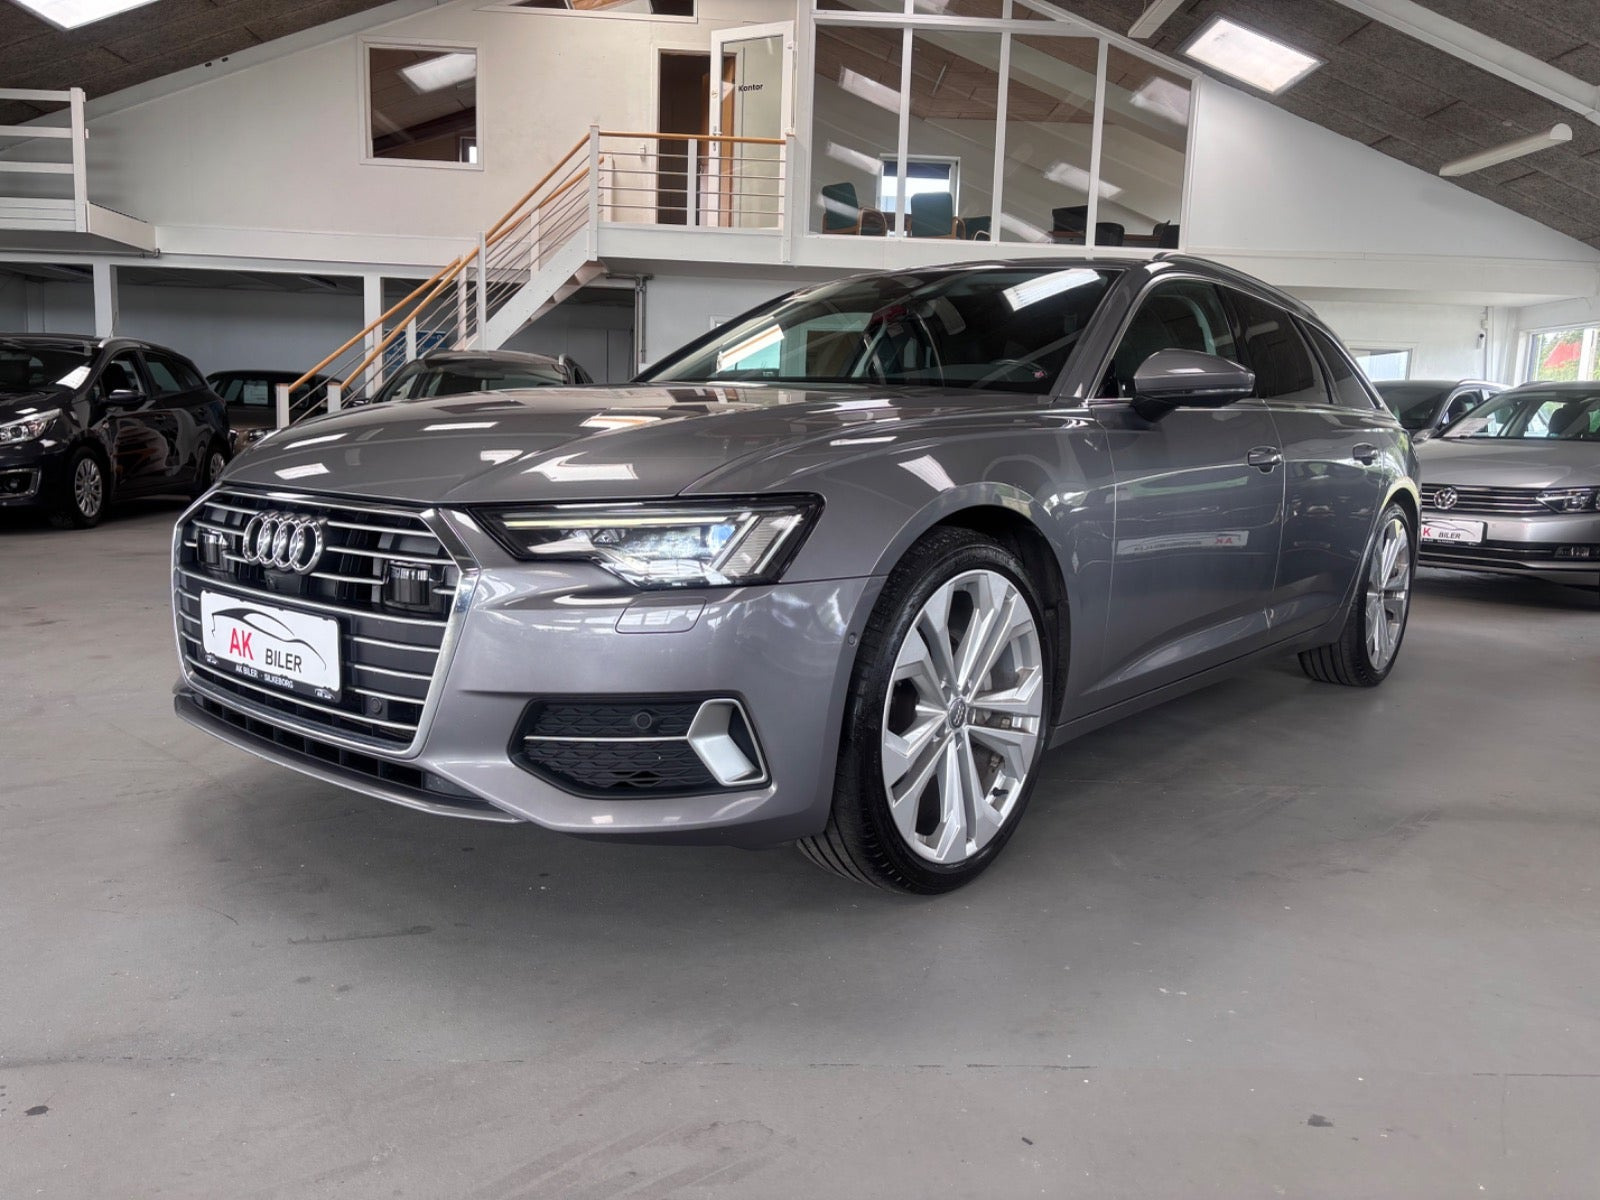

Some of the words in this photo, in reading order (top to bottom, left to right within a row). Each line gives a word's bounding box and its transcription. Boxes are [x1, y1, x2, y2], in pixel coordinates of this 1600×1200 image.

[738, 84, 764, 92] Kontor
[1438, 531, 1461, 540] BILER
[229, 627, 254, 661] AK
[265, 648, 302, 673] BILER
[235, 664, 244, 674] AK
[243, 667, 259, 679] BILER
[264, 673, 294, 688] SILKEBORG
